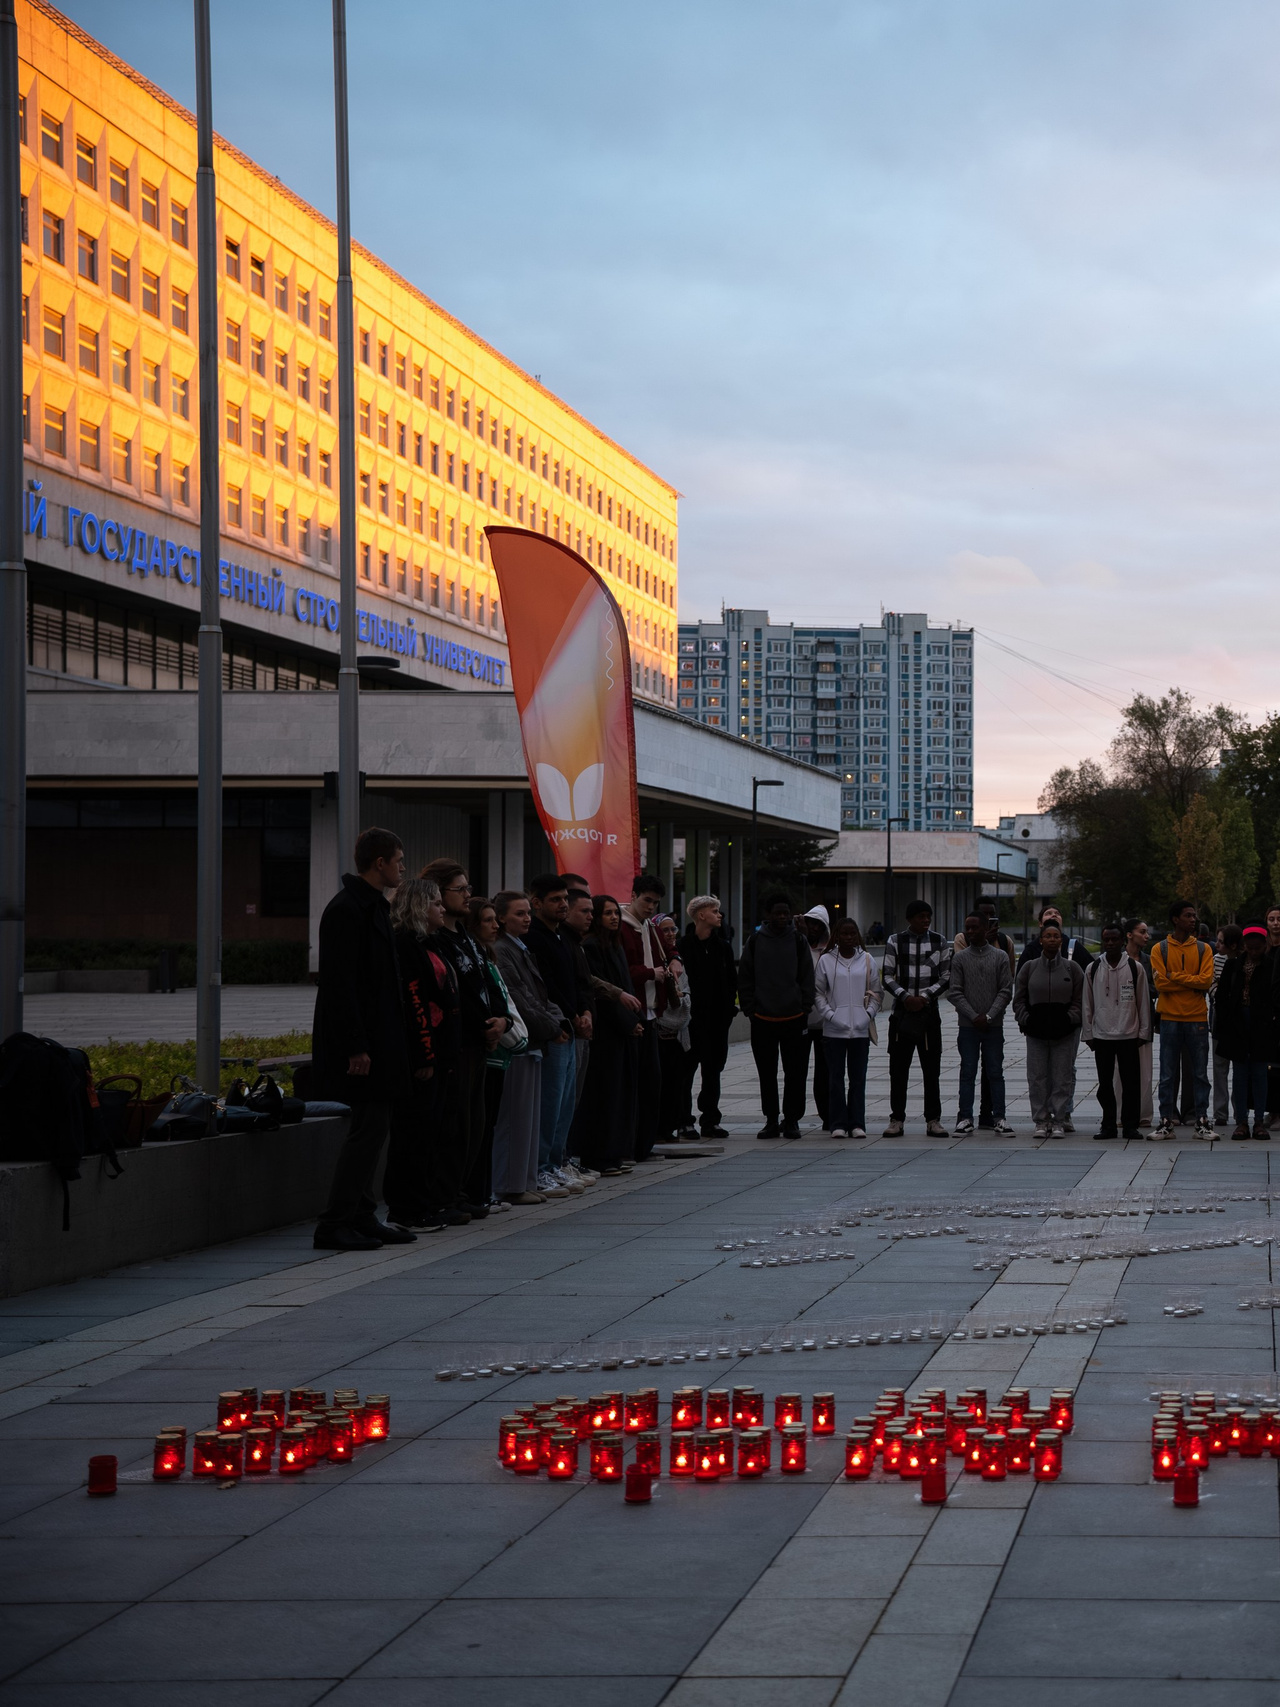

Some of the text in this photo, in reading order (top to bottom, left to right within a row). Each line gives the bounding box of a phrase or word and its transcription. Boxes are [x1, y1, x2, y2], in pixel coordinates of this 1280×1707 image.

[68, 505, 285, 615] ГОСУДАРСТЕННЫЙ
[296, 587, 417, 658] СТРОЕЛЬНЫЙ
[424, 632, 506, 686] УНИВЕРСИТЕТ
